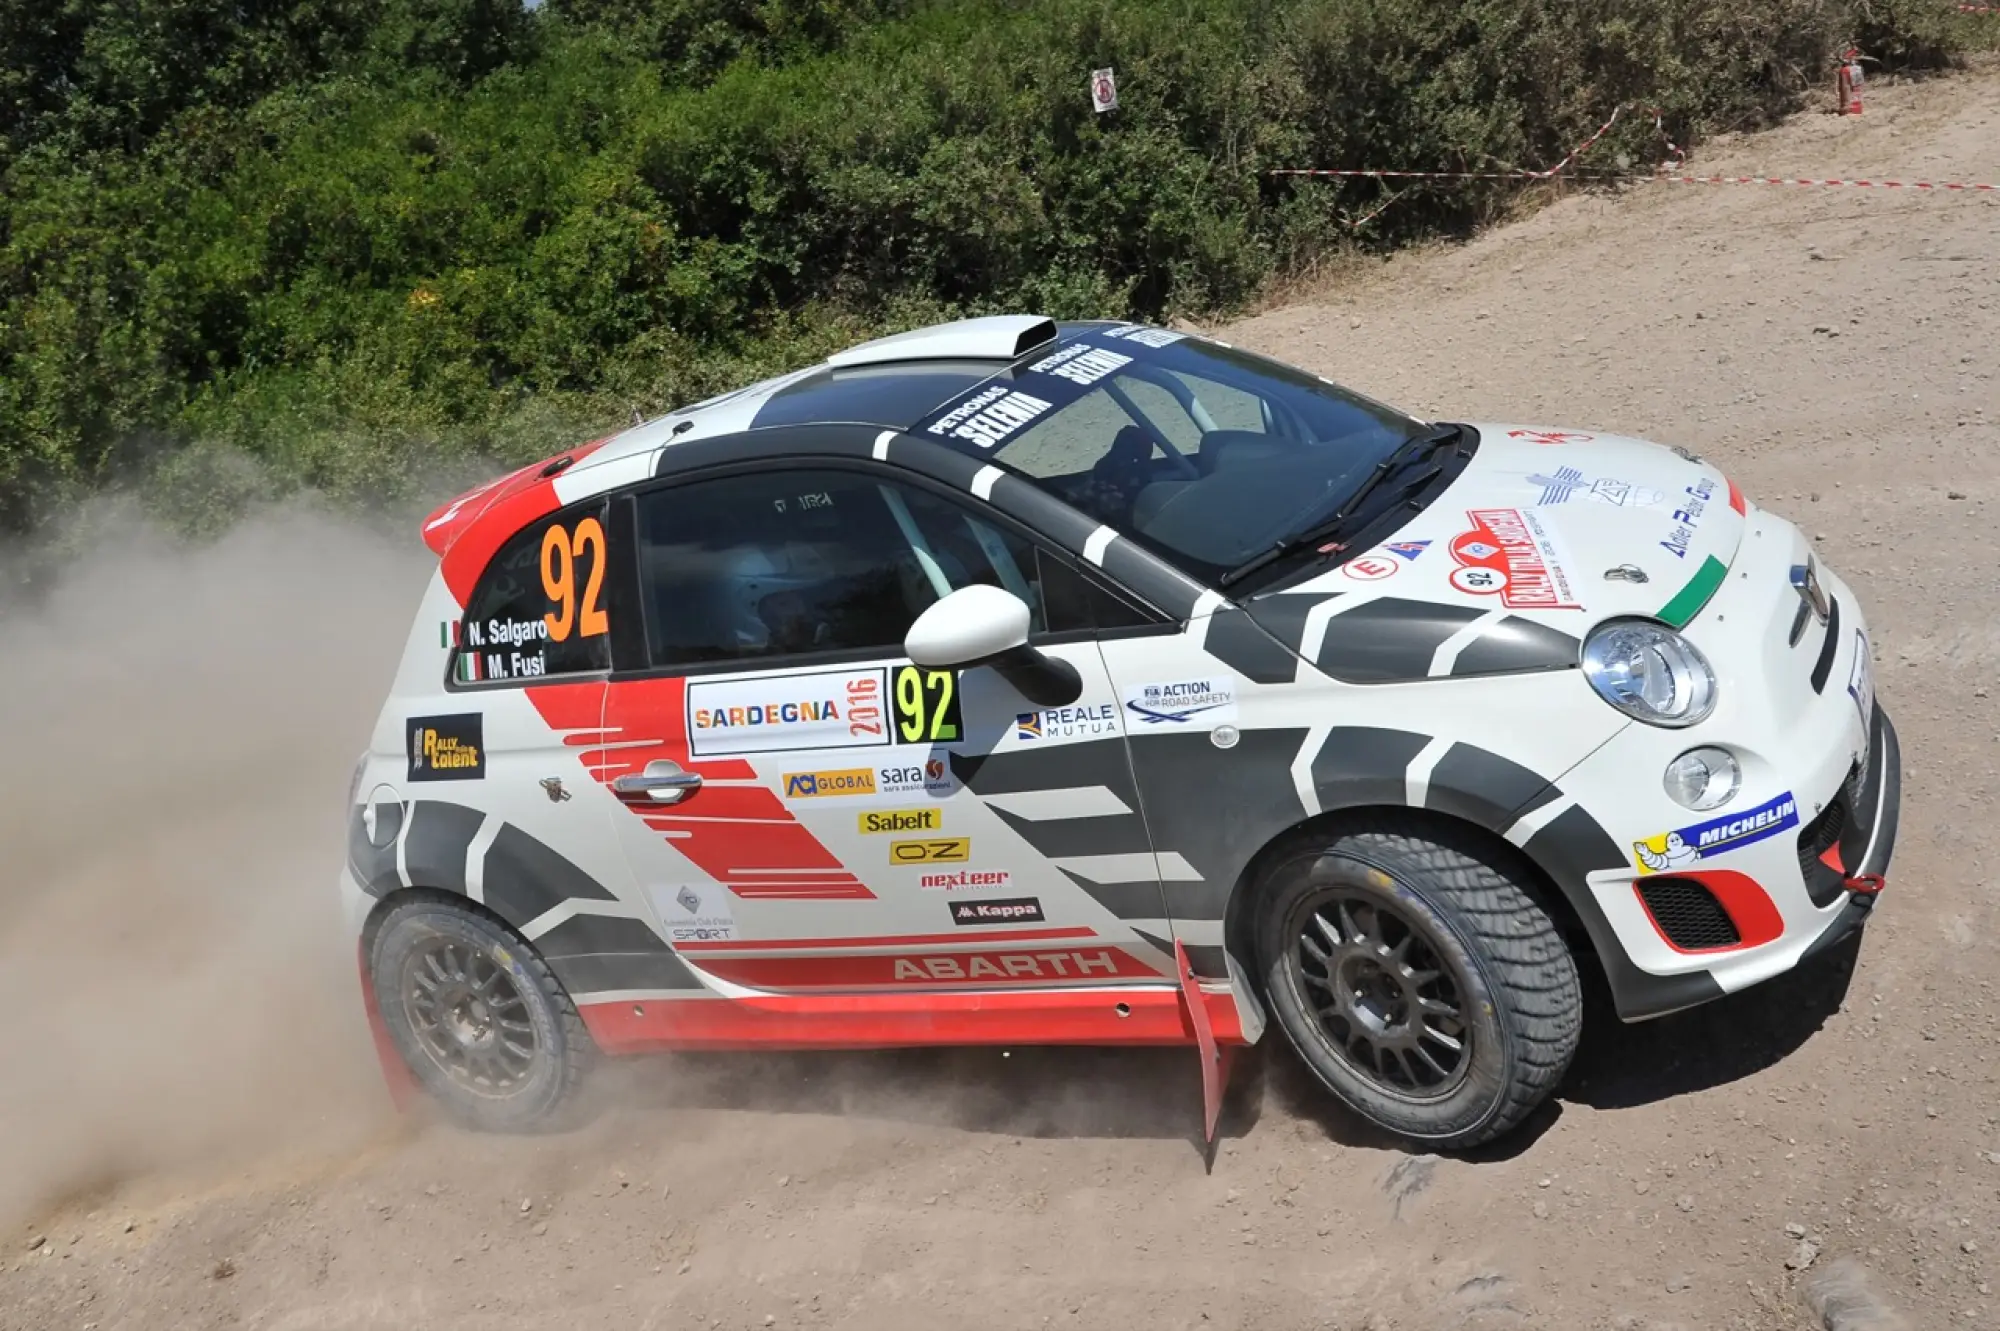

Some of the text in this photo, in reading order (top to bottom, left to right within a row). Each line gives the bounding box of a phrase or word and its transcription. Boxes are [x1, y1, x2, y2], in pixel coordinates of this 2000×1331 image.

[927, 386, 1009, 435] PETRONAS
[953, 391, 1053, 448] SELENIA
[1353, 560, 1386, 575] E
[540, 517, 609, 642] 92
[1466, 572, 1493, 587] 92
[469, 616, 548, 647] N. Salgaro
[487, 649, 546, 679] M. Fusi
[1163, 681, 1210, 697] ACTION
[846, 678, 882, 738] 2016
[897, 666, 957, 742] 92
[1161, 696, 1190, 708] ROAD
[1191, 692, 1231, 705] SAFETY
[696, 700, 840, 729] SARDEGNA
[1046, 704, 1115, 725] REALE
[1048, 721, 1116, 737] MUTUA
[818, 775, 874, 790] GLOBAL
[880, 766, 923, 784] sara
[866, 811, 933, 832] Sabelt
[1699, 800, 1796, 846] MICHELIN
[921, 870, 1010, 891] nexteer
[977, 903, 1038, 918] Kappa
[672, 928, 731, 940] SPORT
[894, 951, 1119, 980] ABARTH
